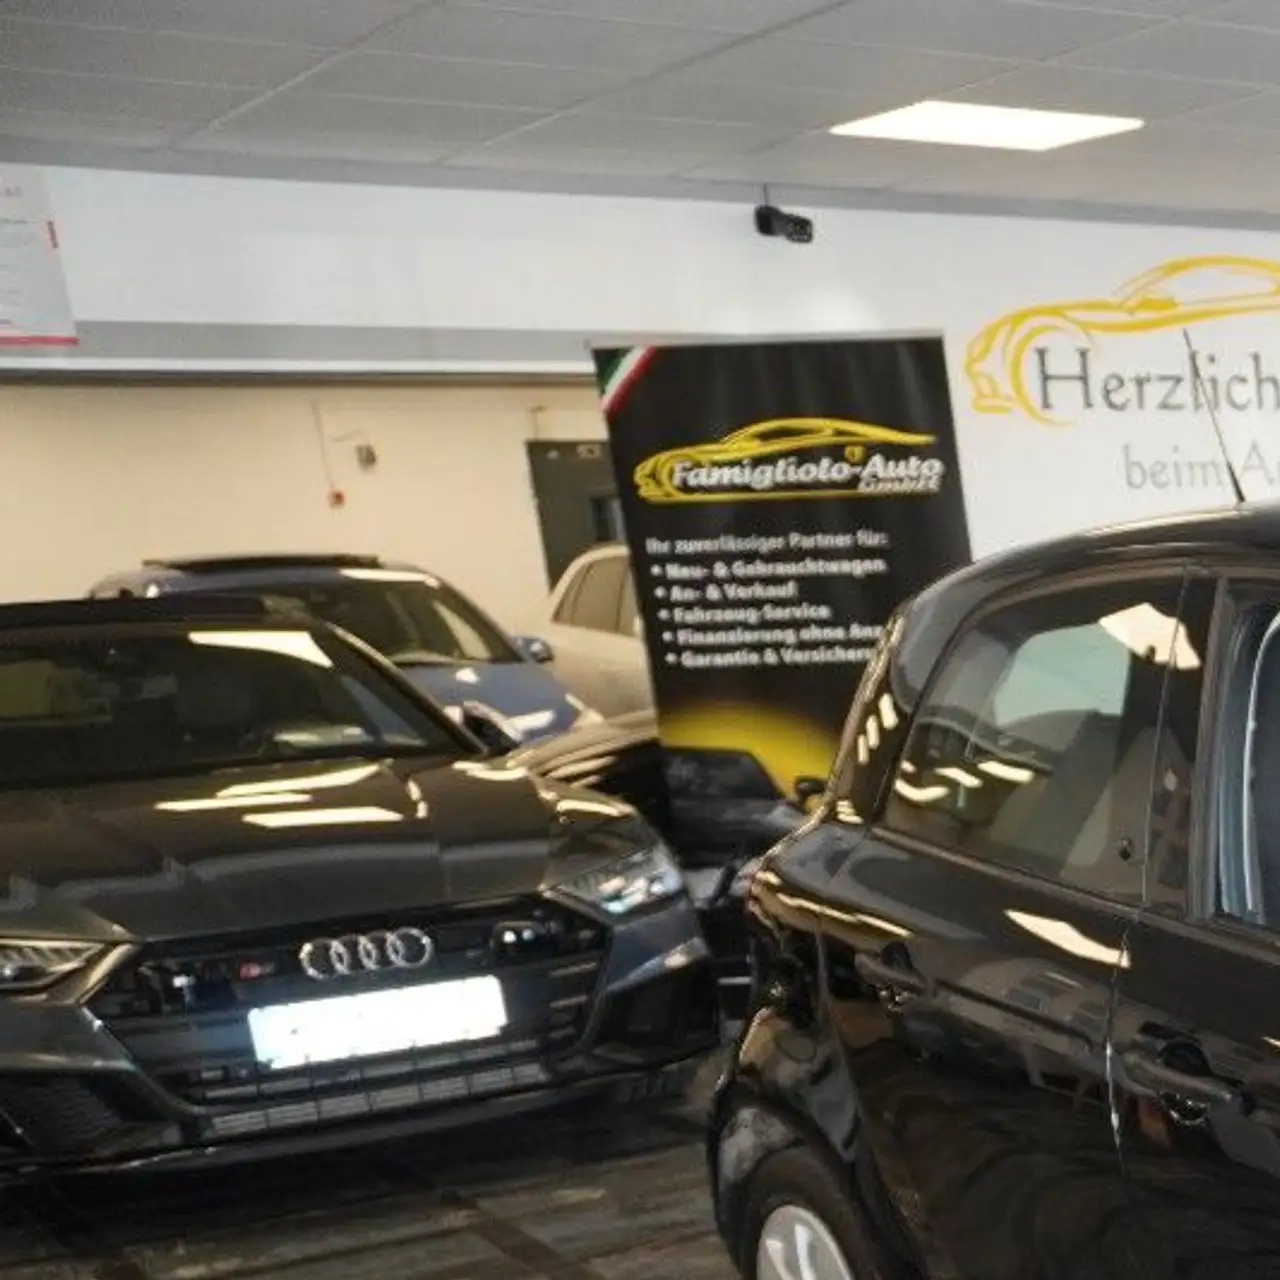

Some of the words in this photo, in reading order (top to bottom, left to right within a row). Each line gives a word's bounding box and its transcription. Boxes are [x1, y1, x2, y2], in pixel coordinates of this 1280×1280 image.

[1122, 443, 1223, 489] beim
[645, 537, 671, 554] Ihr
[788, 531, 854, 550] Partner
[713, 560, 730, 579] &
[732, 557, 888, 579] Gebrauchtwagen
[706, 583, 722, 601] &
[723, 580, 799, 600] Verkauf
[676, 626, 798, 646] Finanzierung
[800, 625, 847, 642] ohne
[681, 650, 761, 669] Garantie
[763, 648, 779, 666] &
